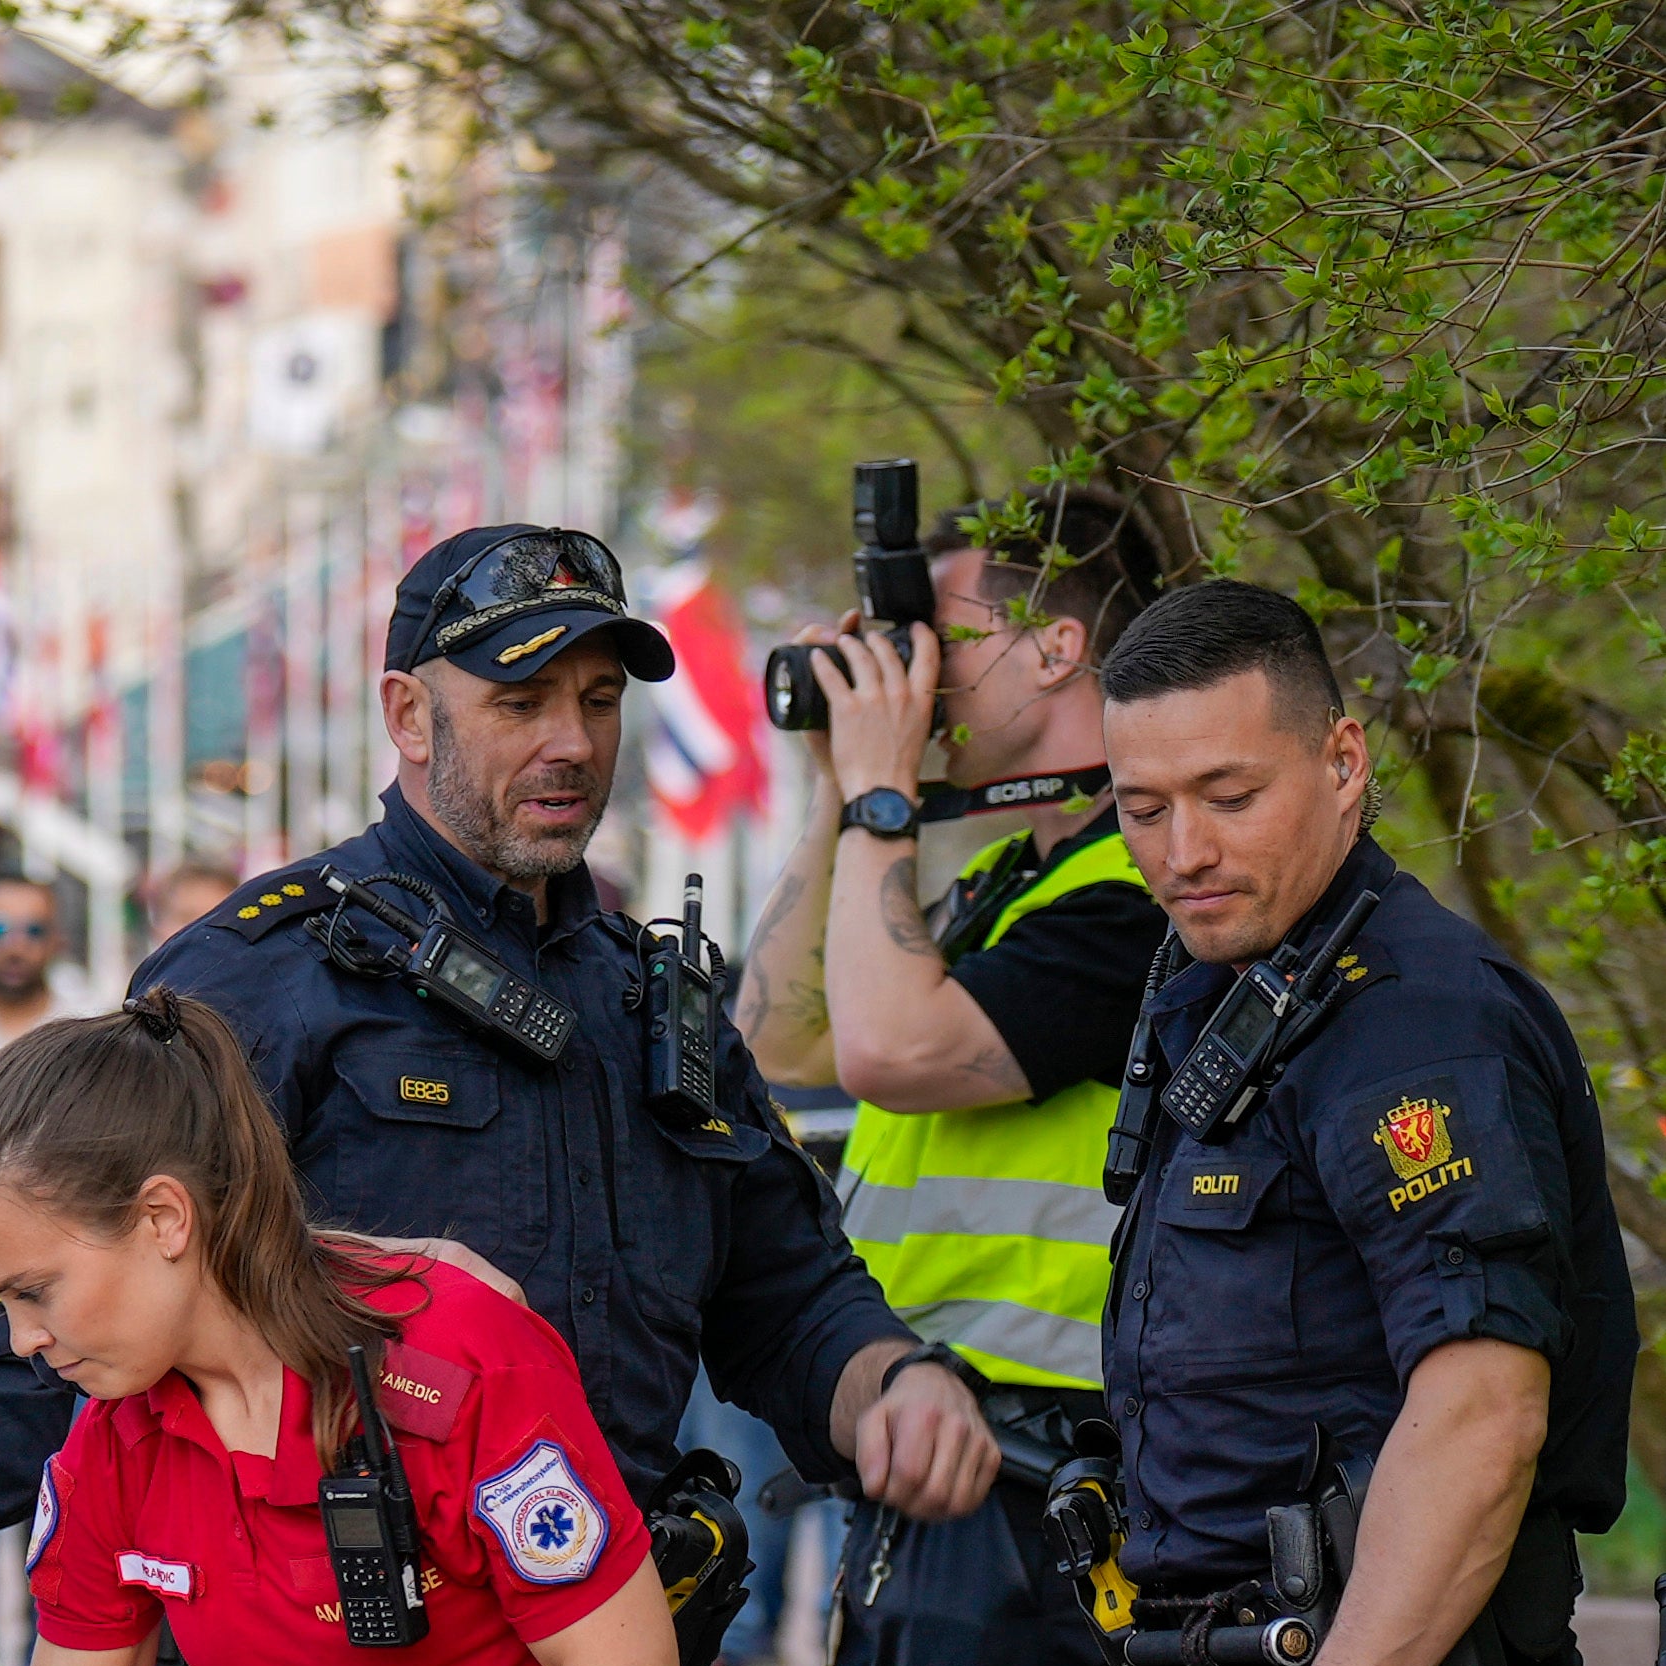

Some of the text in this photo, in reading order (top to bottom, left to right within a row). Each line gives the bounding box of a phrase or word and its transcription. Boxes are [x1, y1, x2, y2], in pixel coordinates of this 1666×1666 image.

[985, 778, 1064, 804] EOS RP
[405, 1079, 449, 1102] E825
[1192, 1174, 1240, 1196] POLITI
[1388, 1157, 1473, 1212] POLITI
[378, 1369, 442, 1404] AMEDIC
